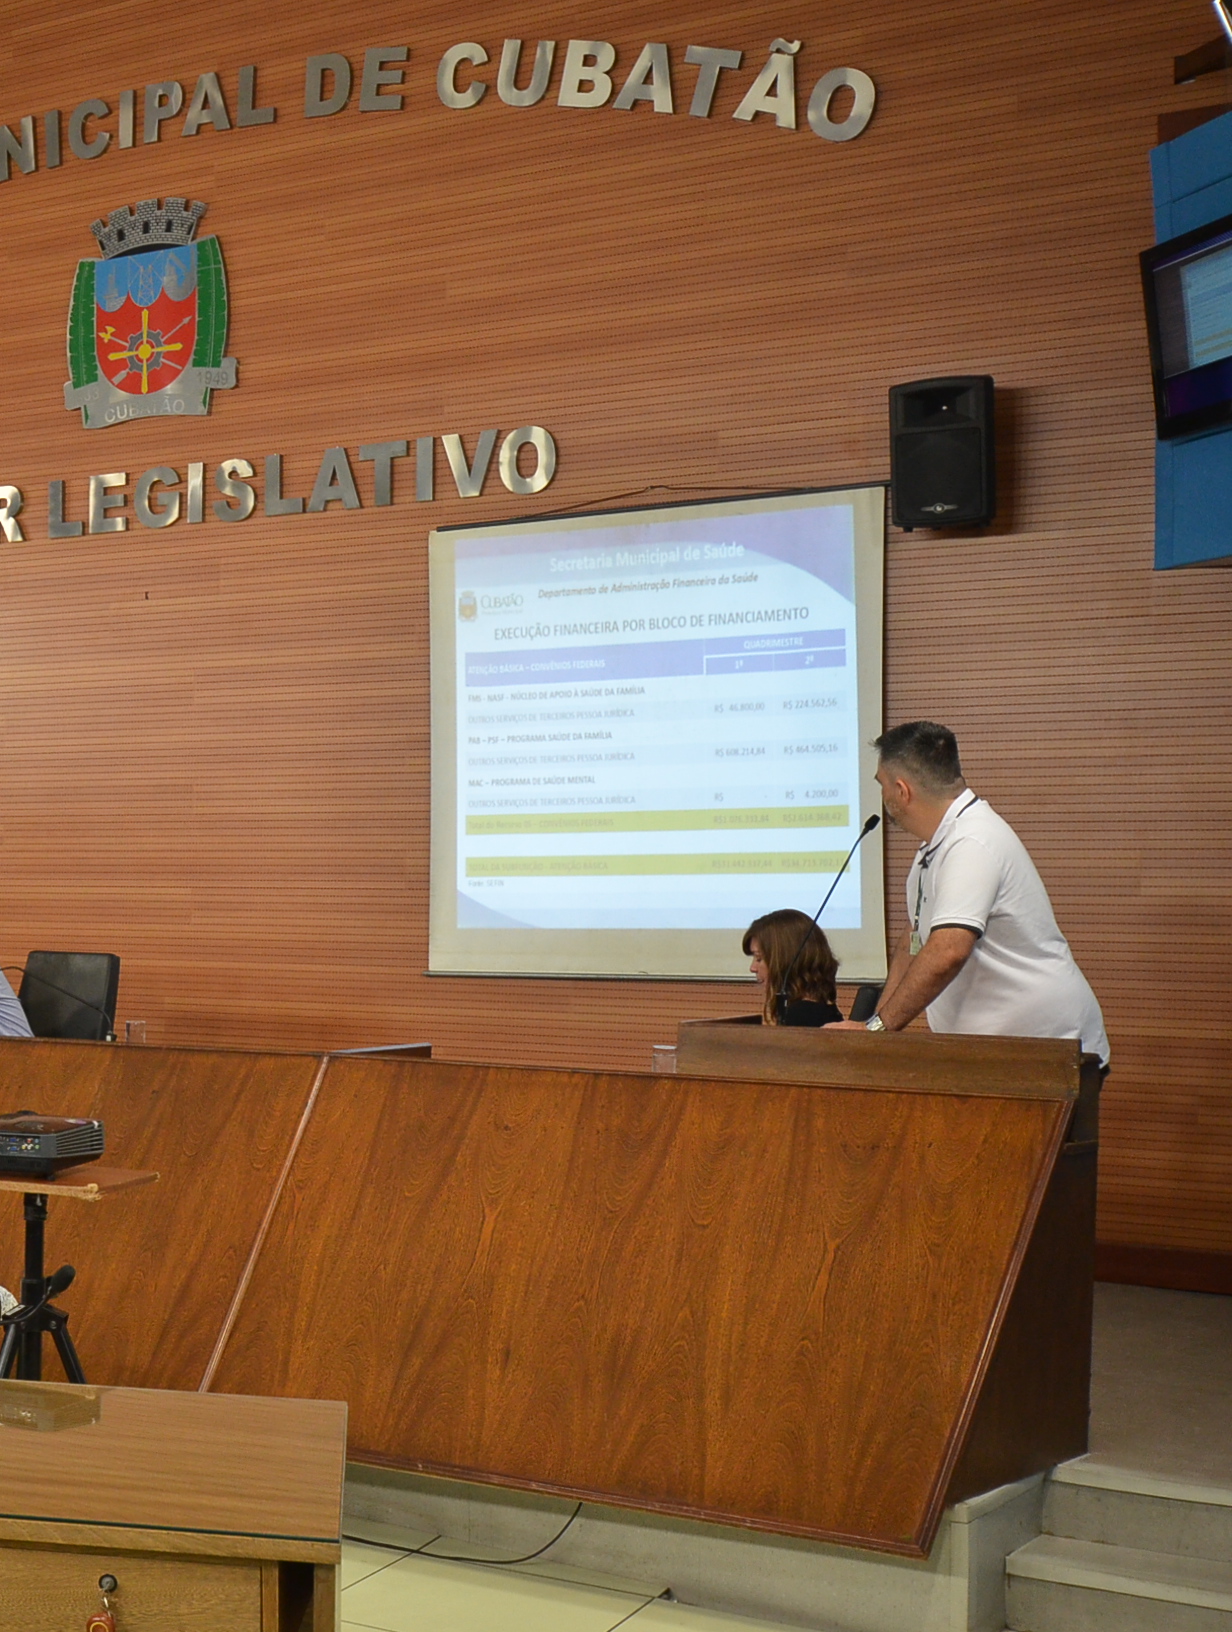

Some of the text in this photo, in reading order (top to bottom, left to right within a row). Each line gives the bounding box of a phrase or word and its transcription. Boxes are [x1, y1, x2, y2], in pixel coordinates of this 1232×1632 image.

[303, 46, 409, 119] DE
[436, 37, 877, 142] CUBATÃO
[48, 425, 557, 539] LEGISLATIVO
[550, 541, 745, 573] Secretaria Municipal de Saúde
[538, 587, 597, 600] Departamento
[599, 584, 609, 595] de
[610, 579, 670, 594] Administração
[672, 576, 717, 590] Financeira
[731, 571, 759, 584] Saúde
[494, 606, 809, 641] EXECUÇÃO FINANCEIRA POR BLOCO DE FINANCIAMENTO
[743, 637, 804, 649] QUADRIMESTRE
[468, 664, 498, 675] ATENÇÃO
[499, 662, 524, 673] BÁSICA
[530, 660, 572, 672] CONVÊNIOS
[572, 659, 606, 669] FEDERAIS
[510, 690, 537, 701] NÚCLEO
[539, 692, 548, 700] DE
[549, 689, 572, 699] APOIO
[580, 687, 603, 698] SAÚDE
[604, 688, 615, 697] DA
[616, 684, 645, 695] FAMÍLIA
[507, 733, 547, 743] PROGRAMA
[548, 731, 571, 741] SAÚDE
[572, 732, 583, 741] DA
[584, 730, 613, 740] FAMÍLIA
[491, 777, 531, 786] PROGRAMA
[532, 777, 542, 785] DE
[543, 774, 566, 785] SAÚDE
[567, 775, 595, 784] MENTAL
